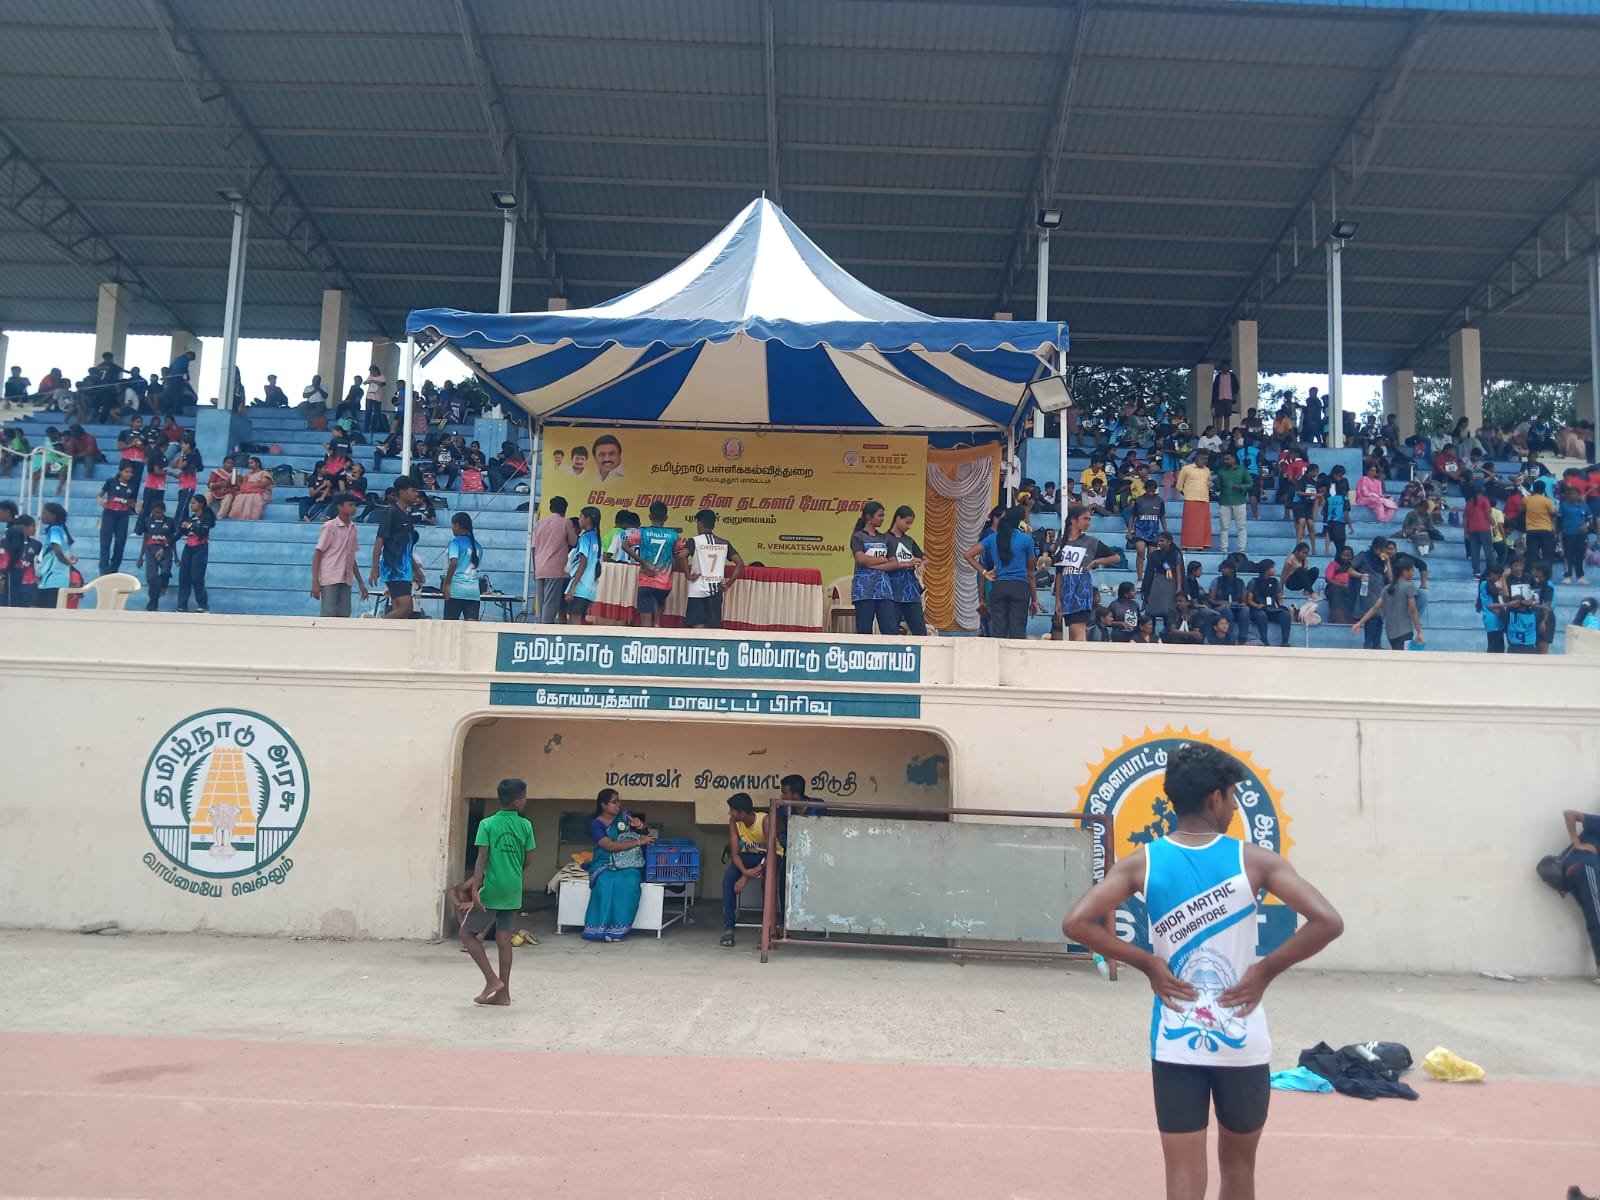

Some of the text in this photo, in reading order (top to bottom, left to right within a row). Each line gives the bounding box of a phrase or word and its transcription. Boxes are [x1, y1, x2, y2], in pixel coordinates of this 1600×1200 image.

[650, 462, 814, 478] தமிழ்நாடு பள்ளிக்கல்வித்துறை
[698, 493, 734, 511] தின
[722, 514, 777, 526] குறுமையம்
[650, 538, 666, 565] 7
[767, 543, 845, 552] VENKATESWARAN
[707, 553, 718, 573] 7
[511, 635, 916, 673] தமிழ்நாடு விளையாட்டு மேம்பாட்டு ஆணையம்
[668, 692, 760, 713] மாவட்டப்
[769, 695, 832, 716] பிரிவு
[153, 720, 296, 812] தமிழ்நாடு அரசு
[605, 768, 858, 796] மாணவர் விளையாட் விடுதி
[142, 852, 295, 898] வாய்மையே வெல்லும்
[1186, 881, 1237, 914] MATRIC
[1169, 904, 1229, 945] COIMBATORE
